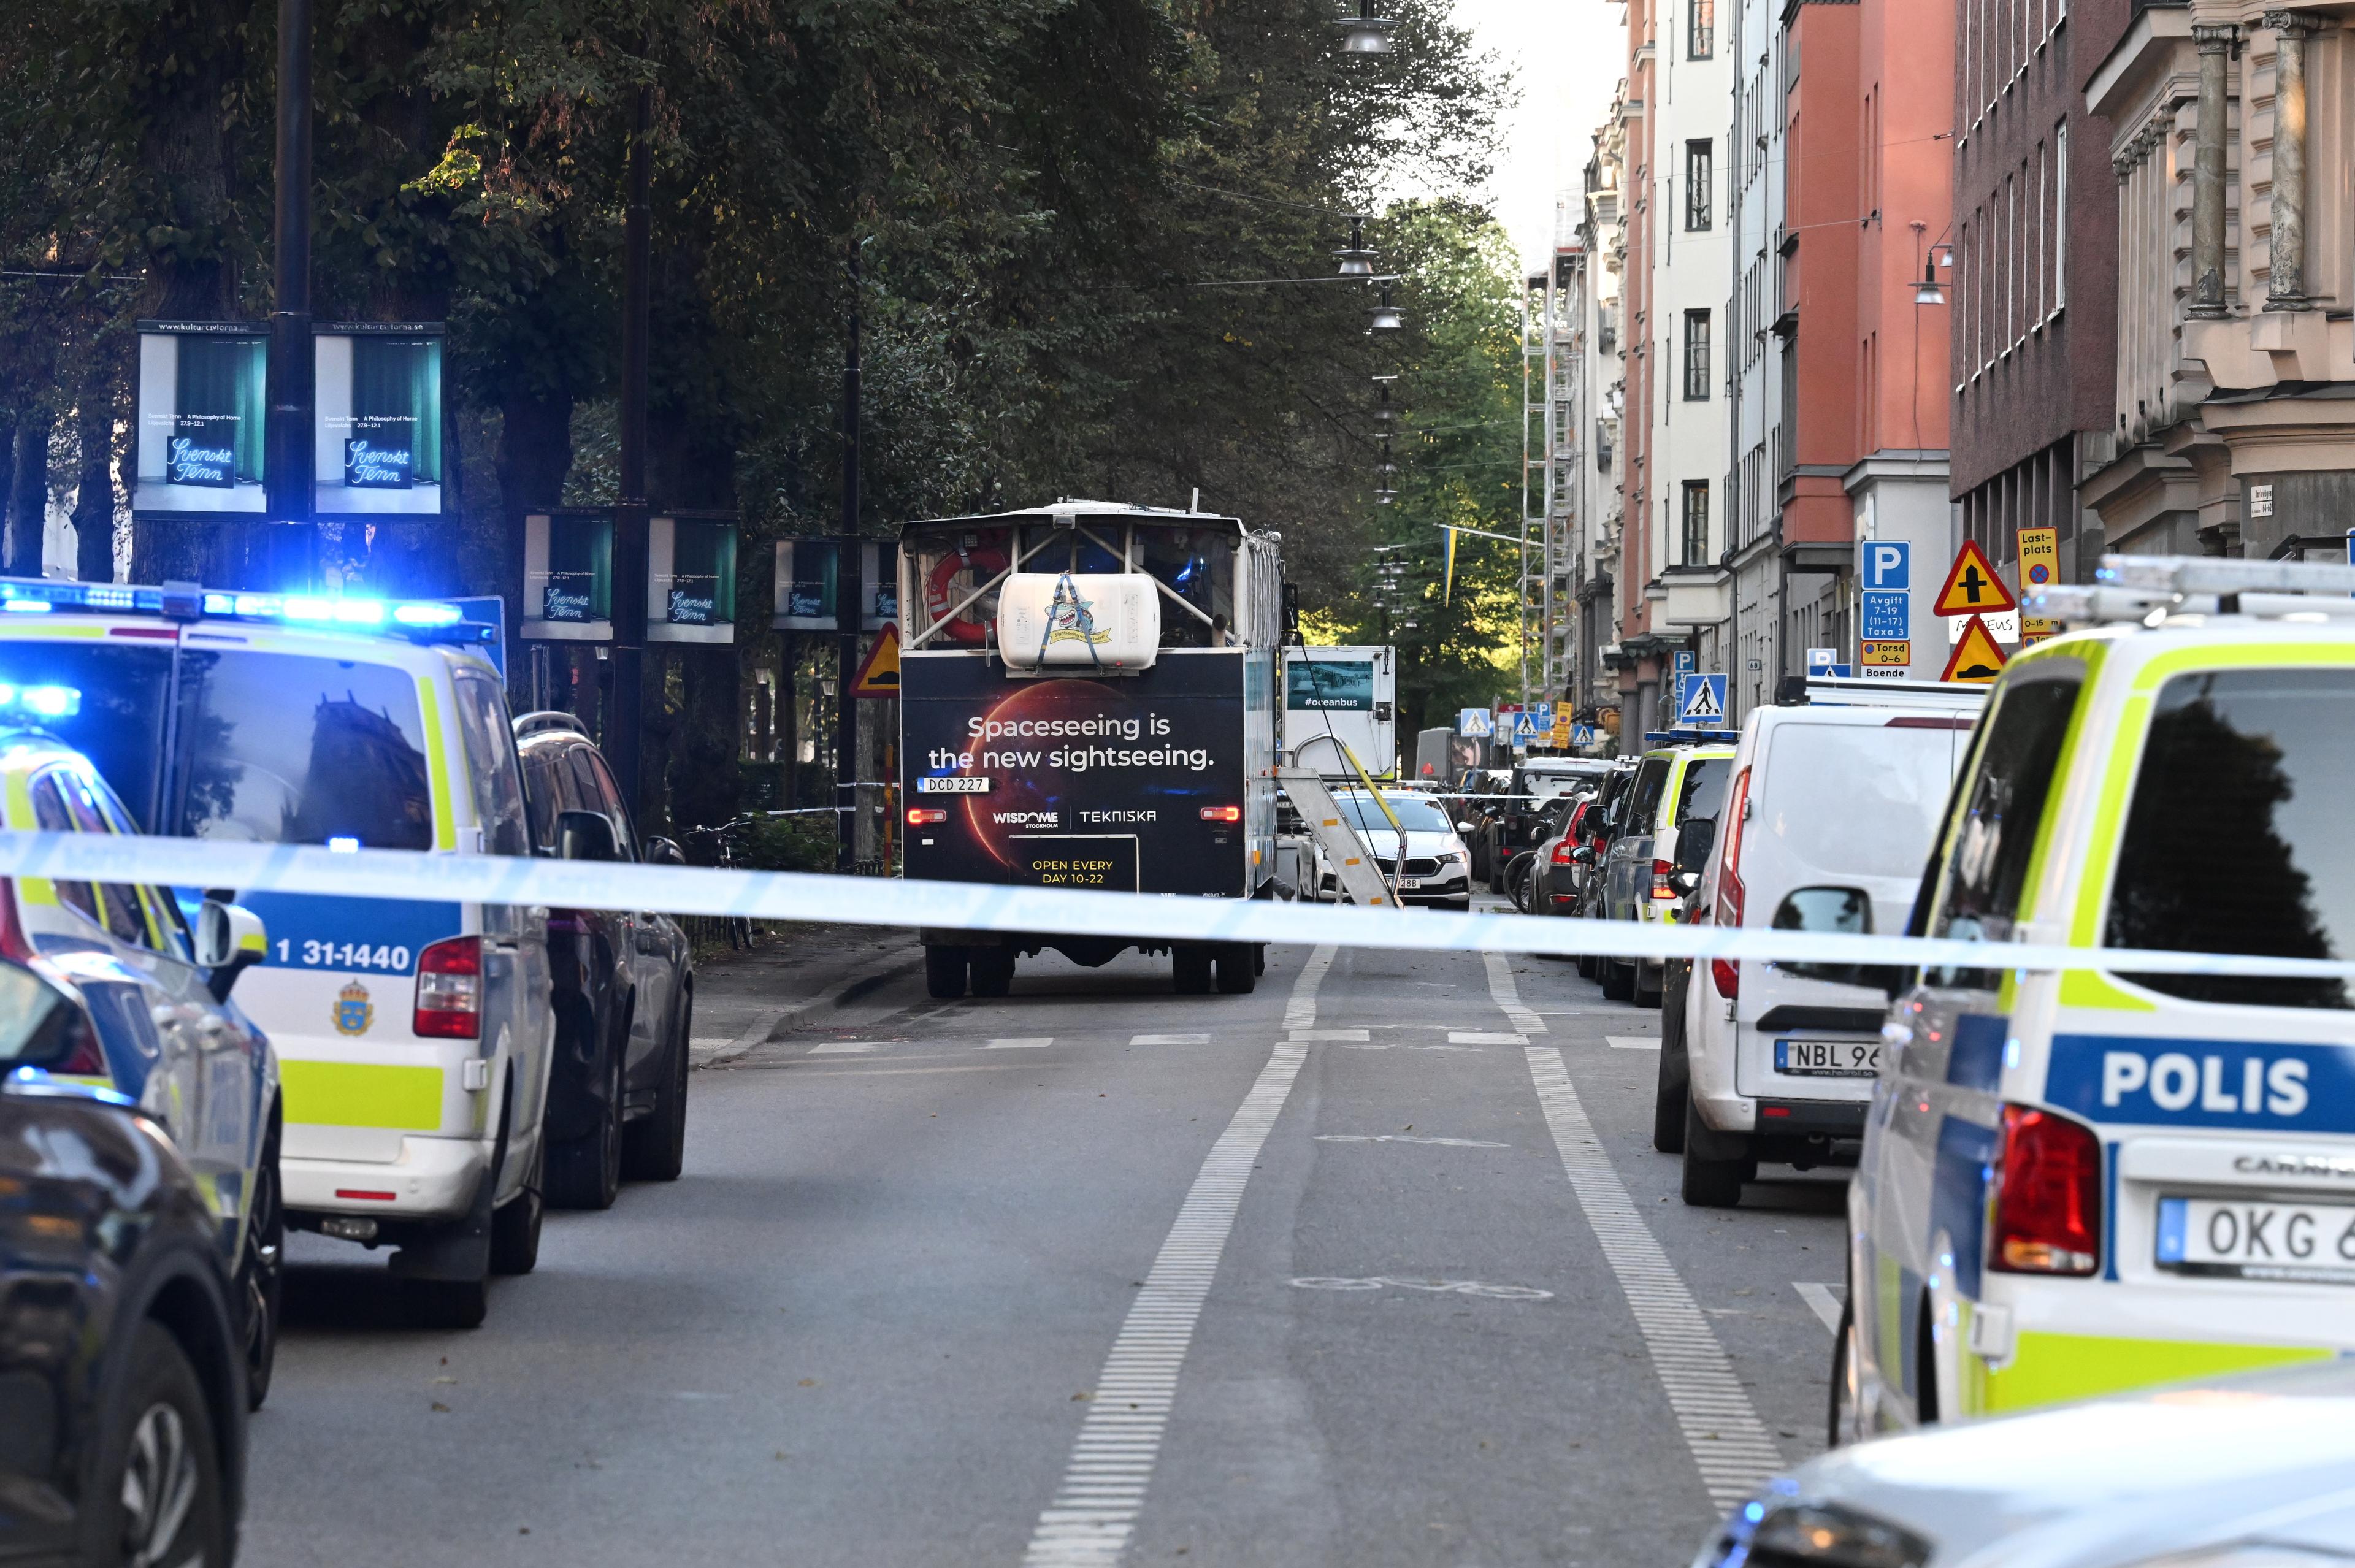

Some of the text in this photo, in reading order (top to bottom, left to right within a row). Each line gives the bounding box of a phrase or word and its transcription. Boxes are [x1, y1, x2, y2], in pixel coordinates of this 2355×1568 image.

[167, 438, 232, 465] Svenskt
[345, 440, 410, 467] Svenskt
[174, 463, 223, 481] Tenn
[351, 465, 401, 484] Tenn
[2023, 534, 2051, 543] Last-
[2024, 545, 2051, 556] plats
[1875, 547, 1901, 584] P
[544, 588, 589, 607] Svenskt
[668, 591, 713, 610] Svenskt
[1870, 596, 1902, 606] Avgift
[548, 605, 583, 619] Tenn
[672, 608, 706, 621] Tenn
[1869, 616, 1902, 626] (11-17)
[1867, 627, 1893, 636] Taxa
[1877, 644, 1905, 652] Torsd
[1680, 653, 1691, 669] P
[1881, 654, 1901, 663] 0-6
[1866, 669, 1904, 678] Boende
[1540, 704, 1548, 716] P
[968, 713, 1170, 742] Spaceseeing is
[928, 743, 1214, 772] the new sightseeing.
[929, 779, 954, 791] DCD
[958, 779, 983, 790] 227
[992, 812, 1059, 824] WISDOME
[1079, 811, 1157, 822] TEKNISKA
[1033, 861, 1113, 870] OPEN EVERY
[1043, 874, 1103, 883] DAY 10-22
[277, 938, 410, 971] 1 31-1440
[1797, 1044, 1842, 1067] NBL
[2102, 1050, 2310, 1117] POLIS
[2208, 1208, 2315, 1259] OKG
